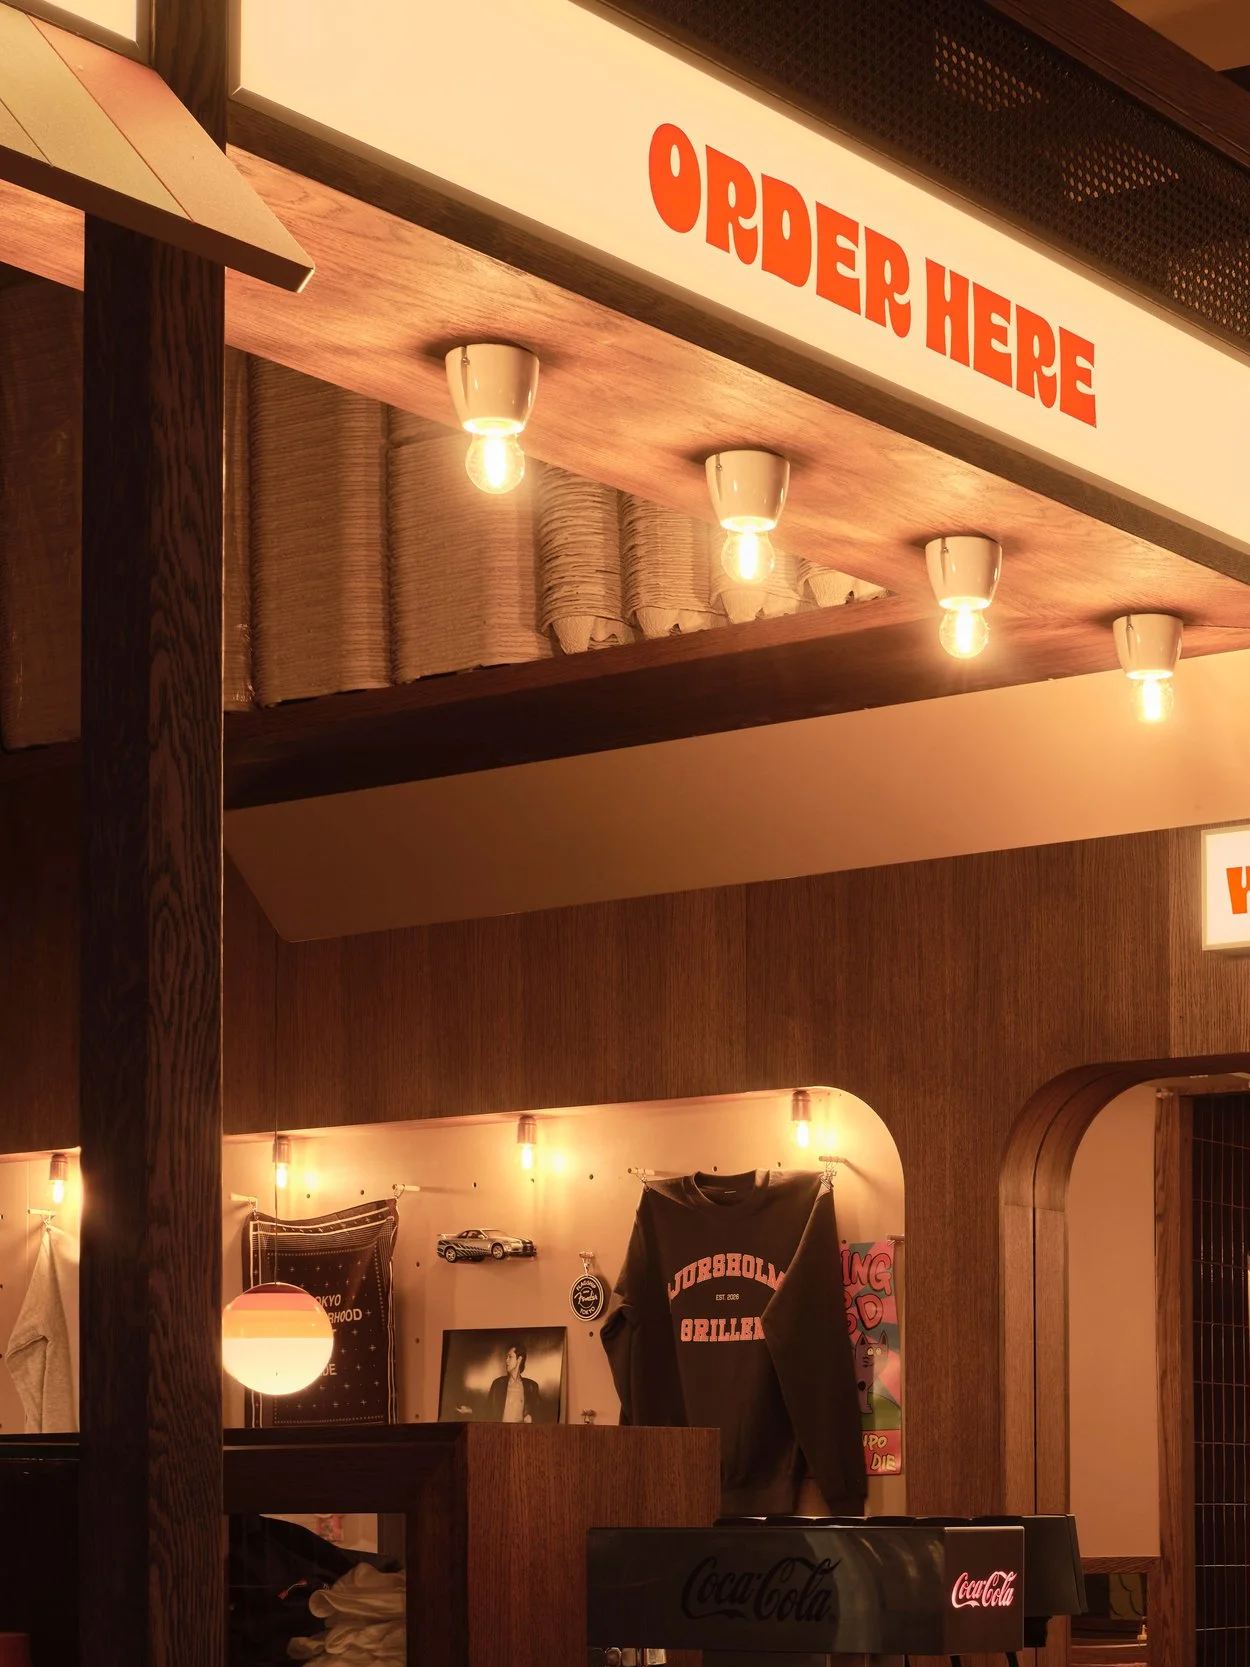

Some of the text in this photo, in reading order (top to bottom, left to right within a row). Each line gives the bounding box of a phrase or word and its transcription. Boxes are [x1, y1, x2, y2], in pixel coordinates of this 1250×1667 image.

[648, 122, 1097, 429] ORDER HERE
[841, 1248, 893, 1296] ING
[680, 1555, 842, 1622] Coca-Cola
[951, 1570, 1018, 1609] Coca-Cola
